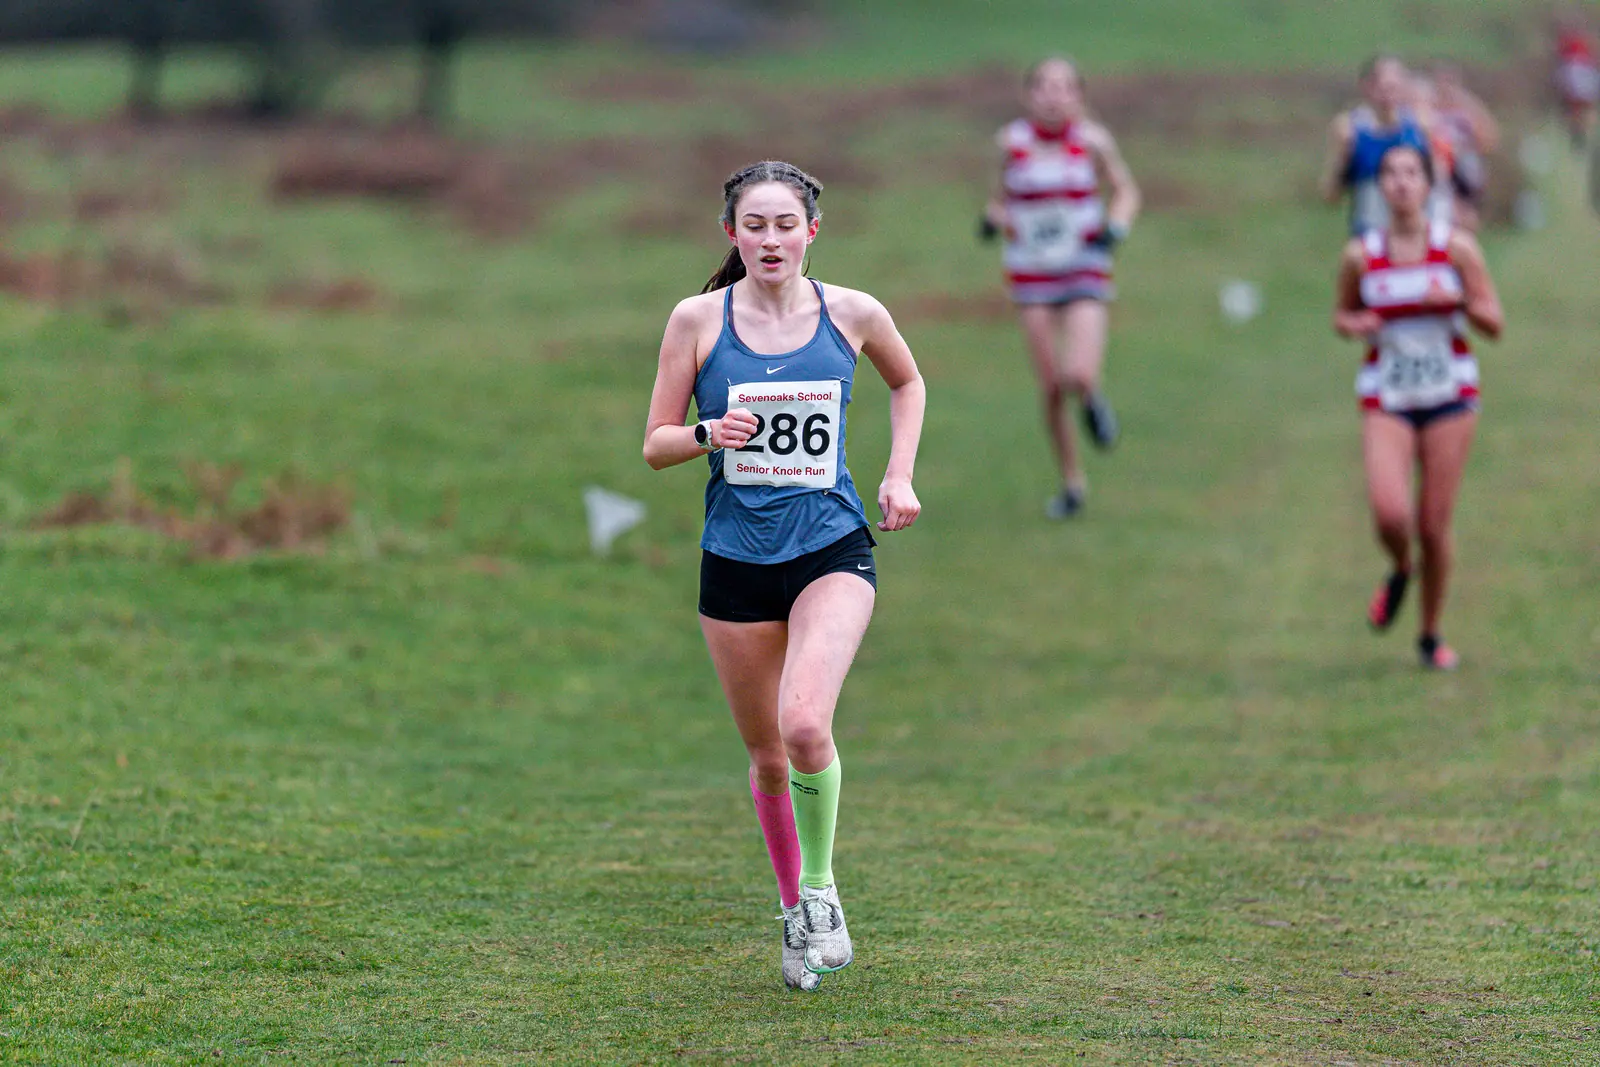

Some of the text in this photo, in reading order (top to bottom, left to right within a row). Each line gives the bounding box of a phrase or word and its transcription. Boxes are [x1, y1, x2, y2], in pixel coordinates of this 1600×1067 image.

[738, 392, 832, 403] Sevenoaks School
[735, 413, 831, 456] 286
[736, 463, 825, 476] Senior Knole Run
